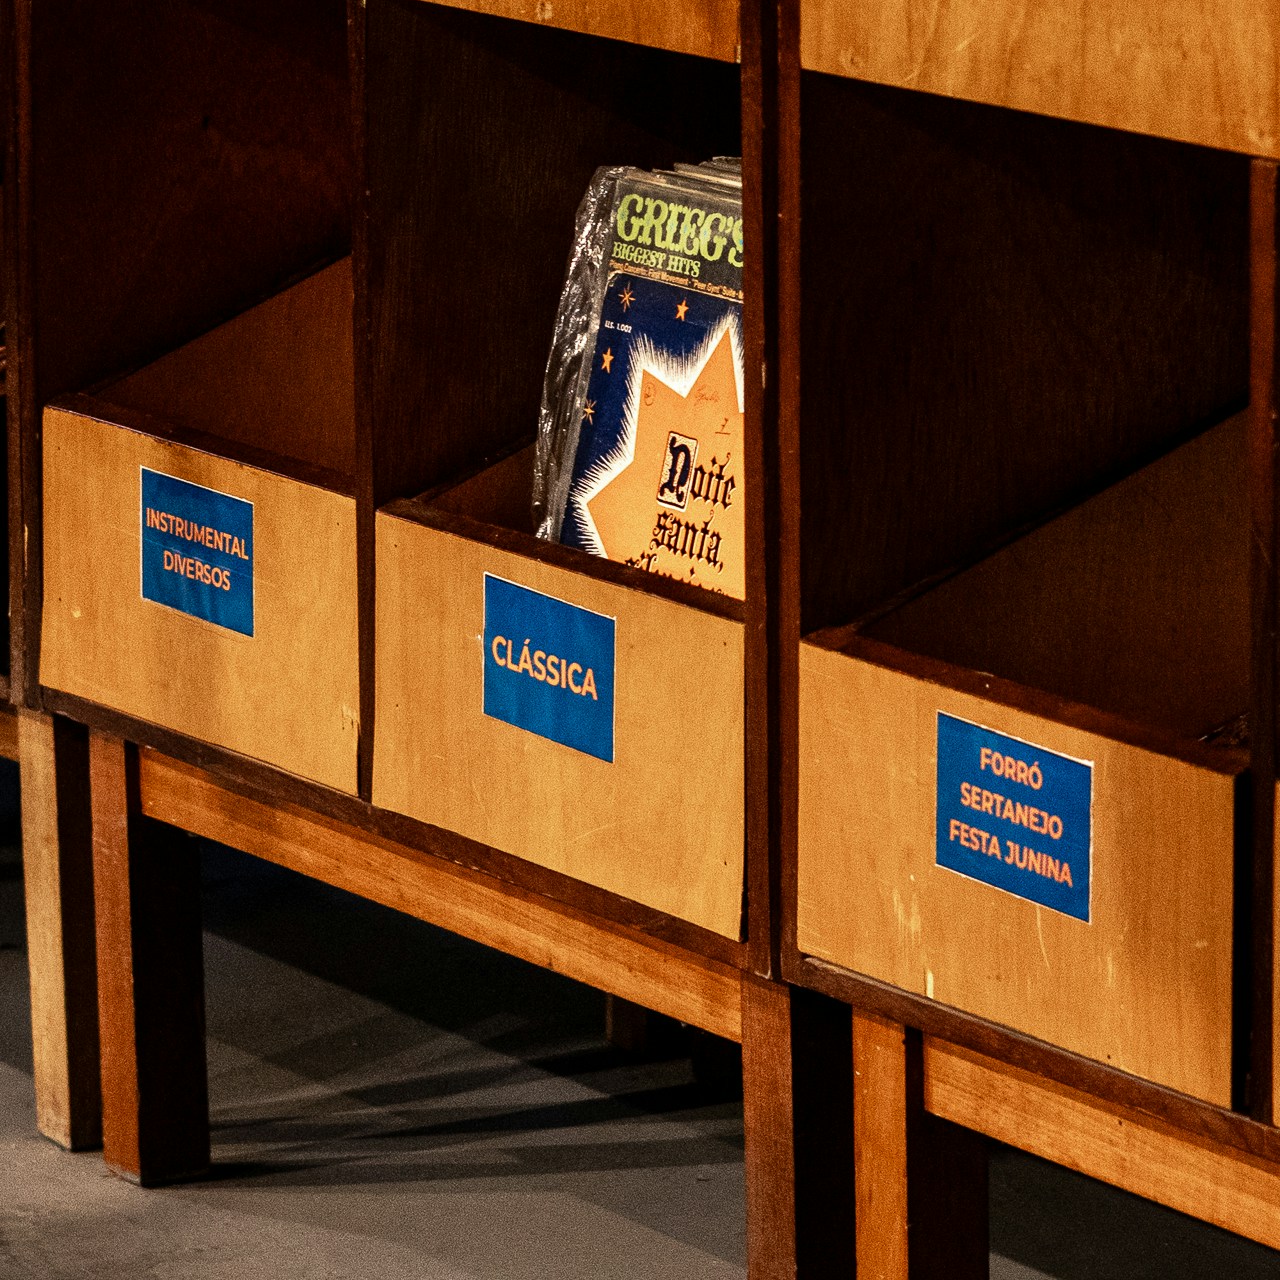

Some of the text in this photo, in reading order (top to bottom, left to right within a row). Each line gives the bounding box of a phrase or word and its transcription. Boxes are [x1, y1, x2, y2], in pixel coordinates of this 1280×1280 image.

[612, 241, 701, 278] BIGGEST HITS
[146, 506, 249, 560] INSTRUMENTAL
[163, 549, 231, 592] DIVERSOS
[491, 639, 599, 701] CLÁSSICA
[980, 746, 1043, 790] FORRÓ
[960, 781, 1063, 840] SERTANEJO
[949, 819, 1073, 888] FESTA JUNINA
